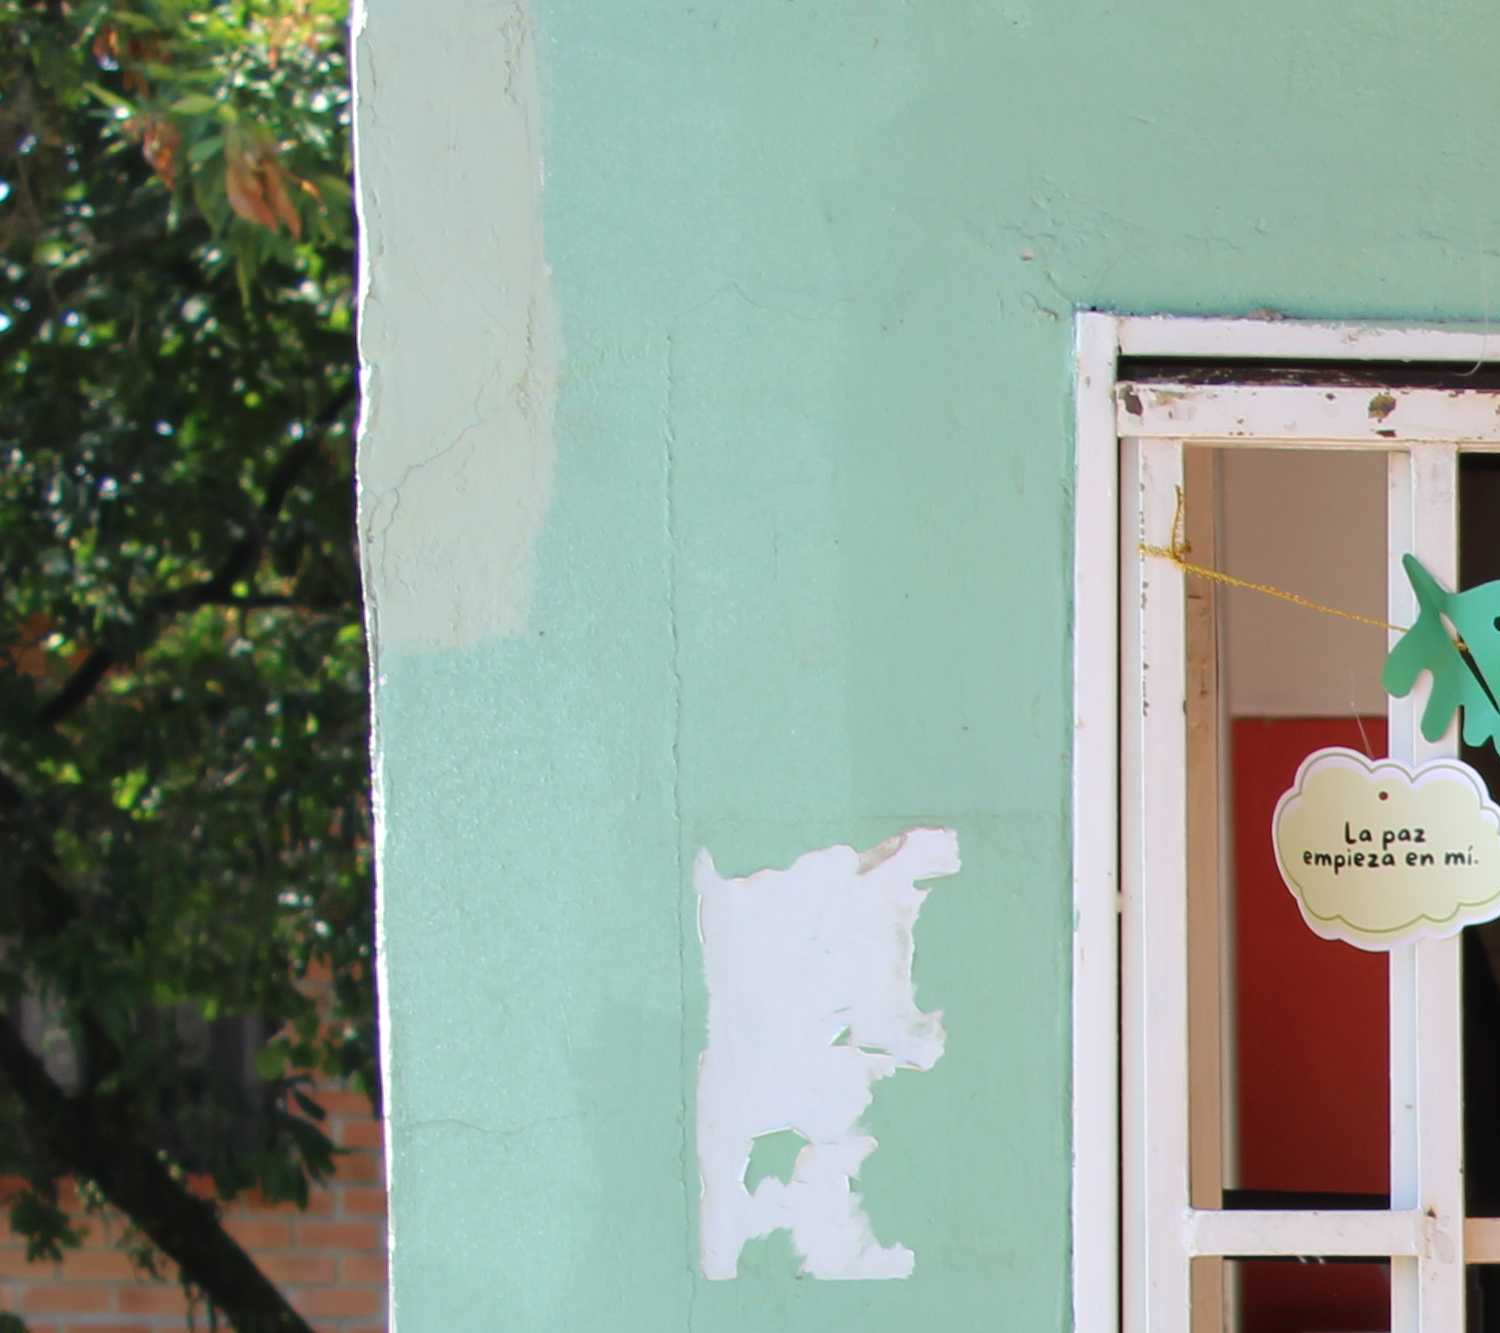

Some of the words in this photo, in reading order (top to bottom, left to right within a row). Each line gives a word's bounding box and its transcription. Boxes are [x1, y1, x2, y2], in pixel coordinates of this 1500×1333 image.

[1344, 821, 1372, 844] La
[1382, 828, 1426, 850] paz
[1303, 848, 1395, 875] empieza
[1405, 850, 1434, 866] en
[1445, 845, 1479, 866] mí.
